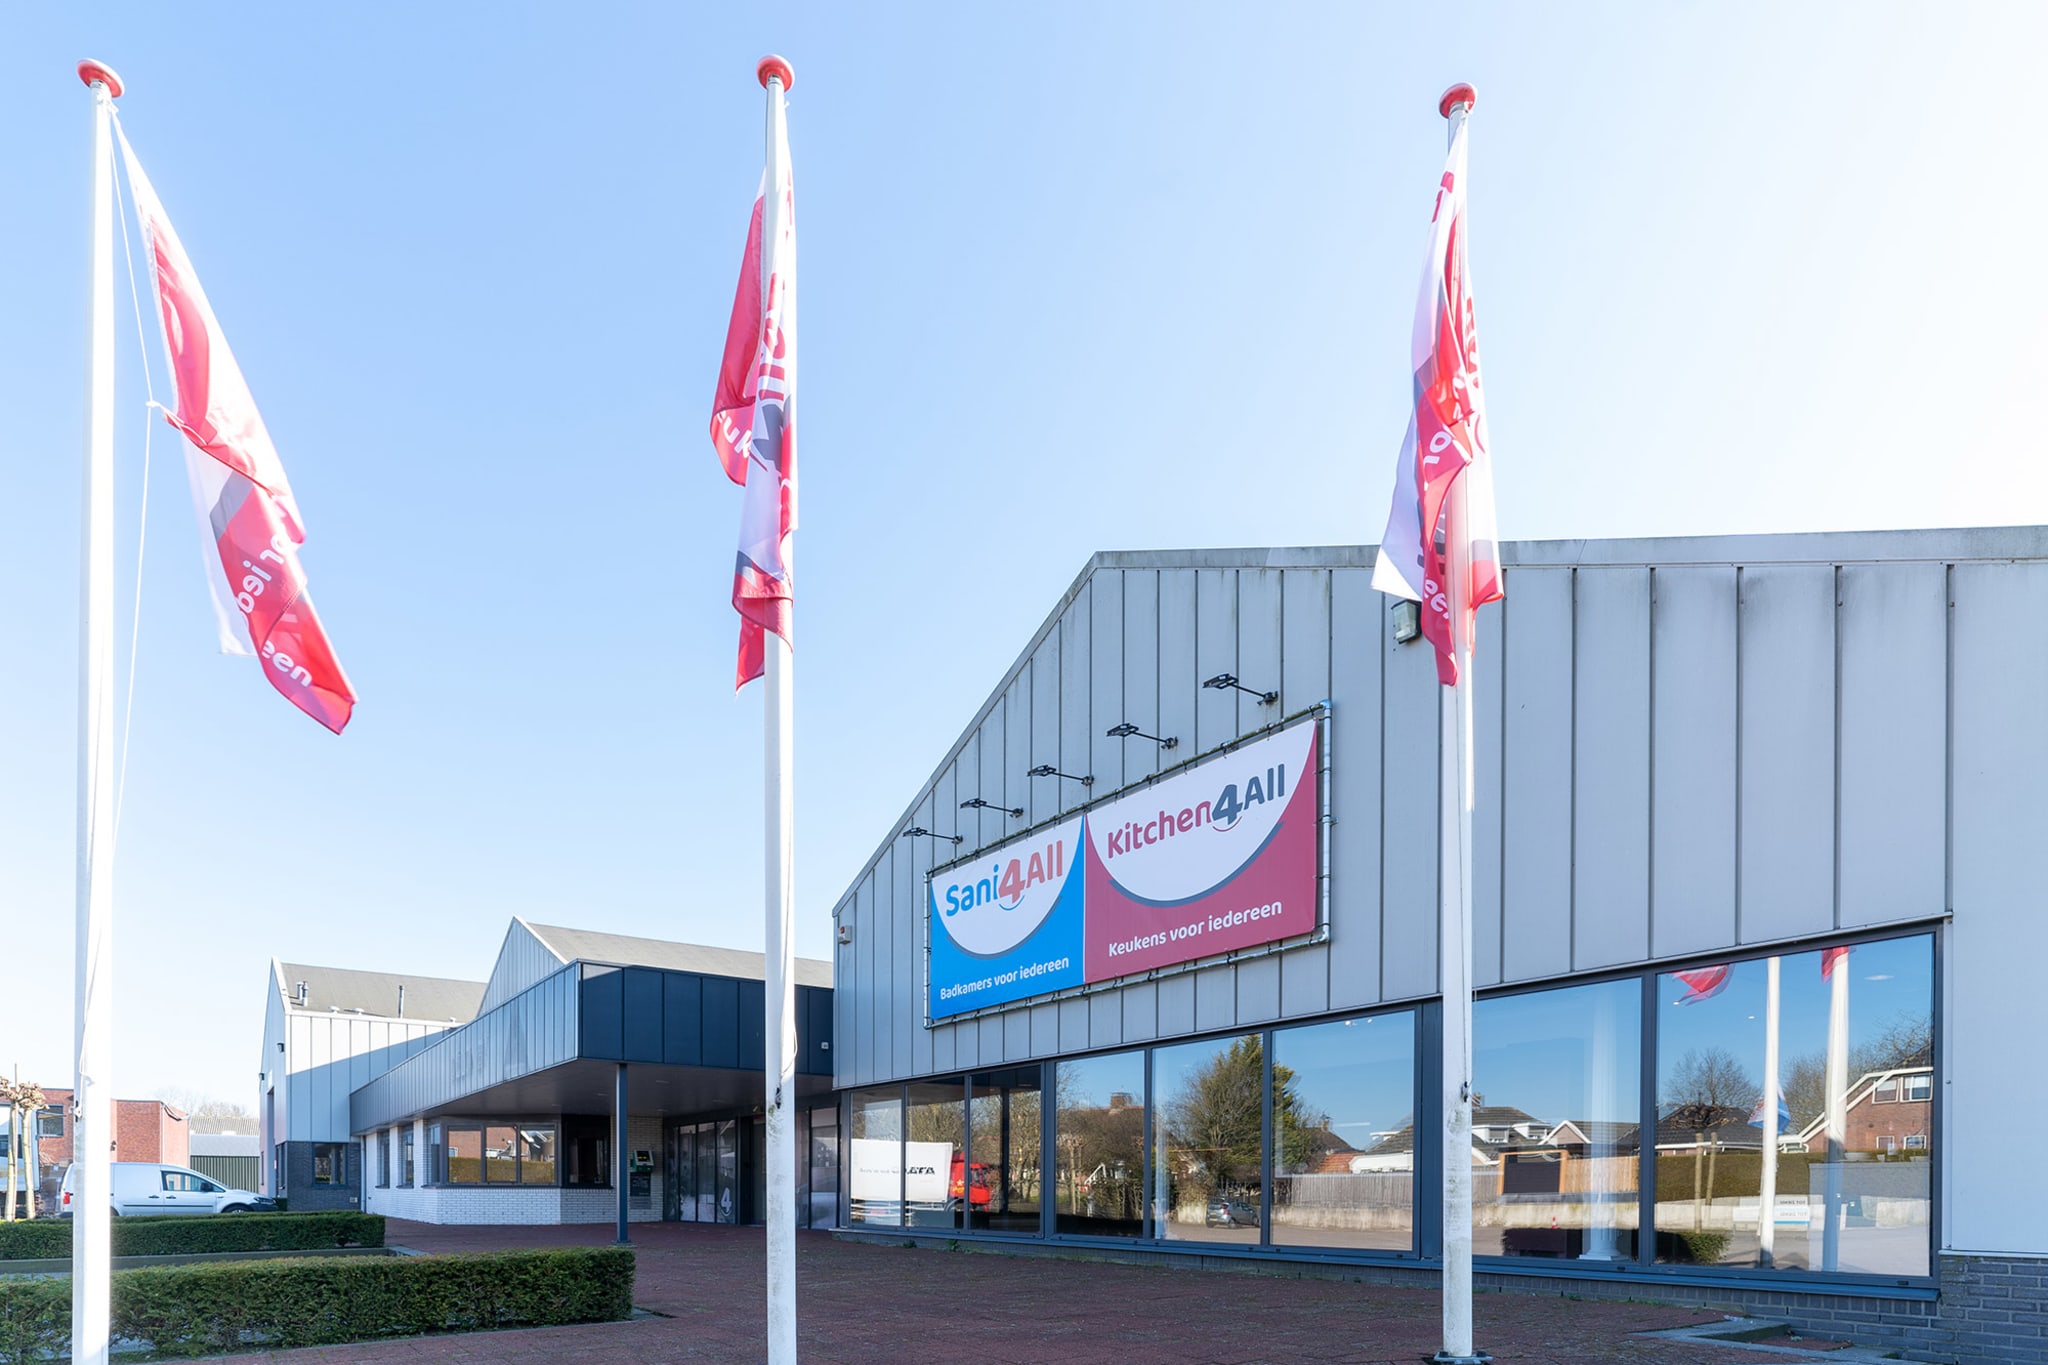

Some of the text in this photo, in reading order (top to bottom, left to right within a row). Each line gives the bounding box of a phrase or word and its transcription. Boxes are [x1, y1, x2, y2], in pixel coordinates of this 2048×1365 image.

[1107, 763, 1286, 860] Kitchen4All
[945, 839, 1063, 917] Sani4All
[1108, 900, 1283, 958] Keukens voor iedereen
[939, 956, 1070, 1001] Badkamers voor iedereen
